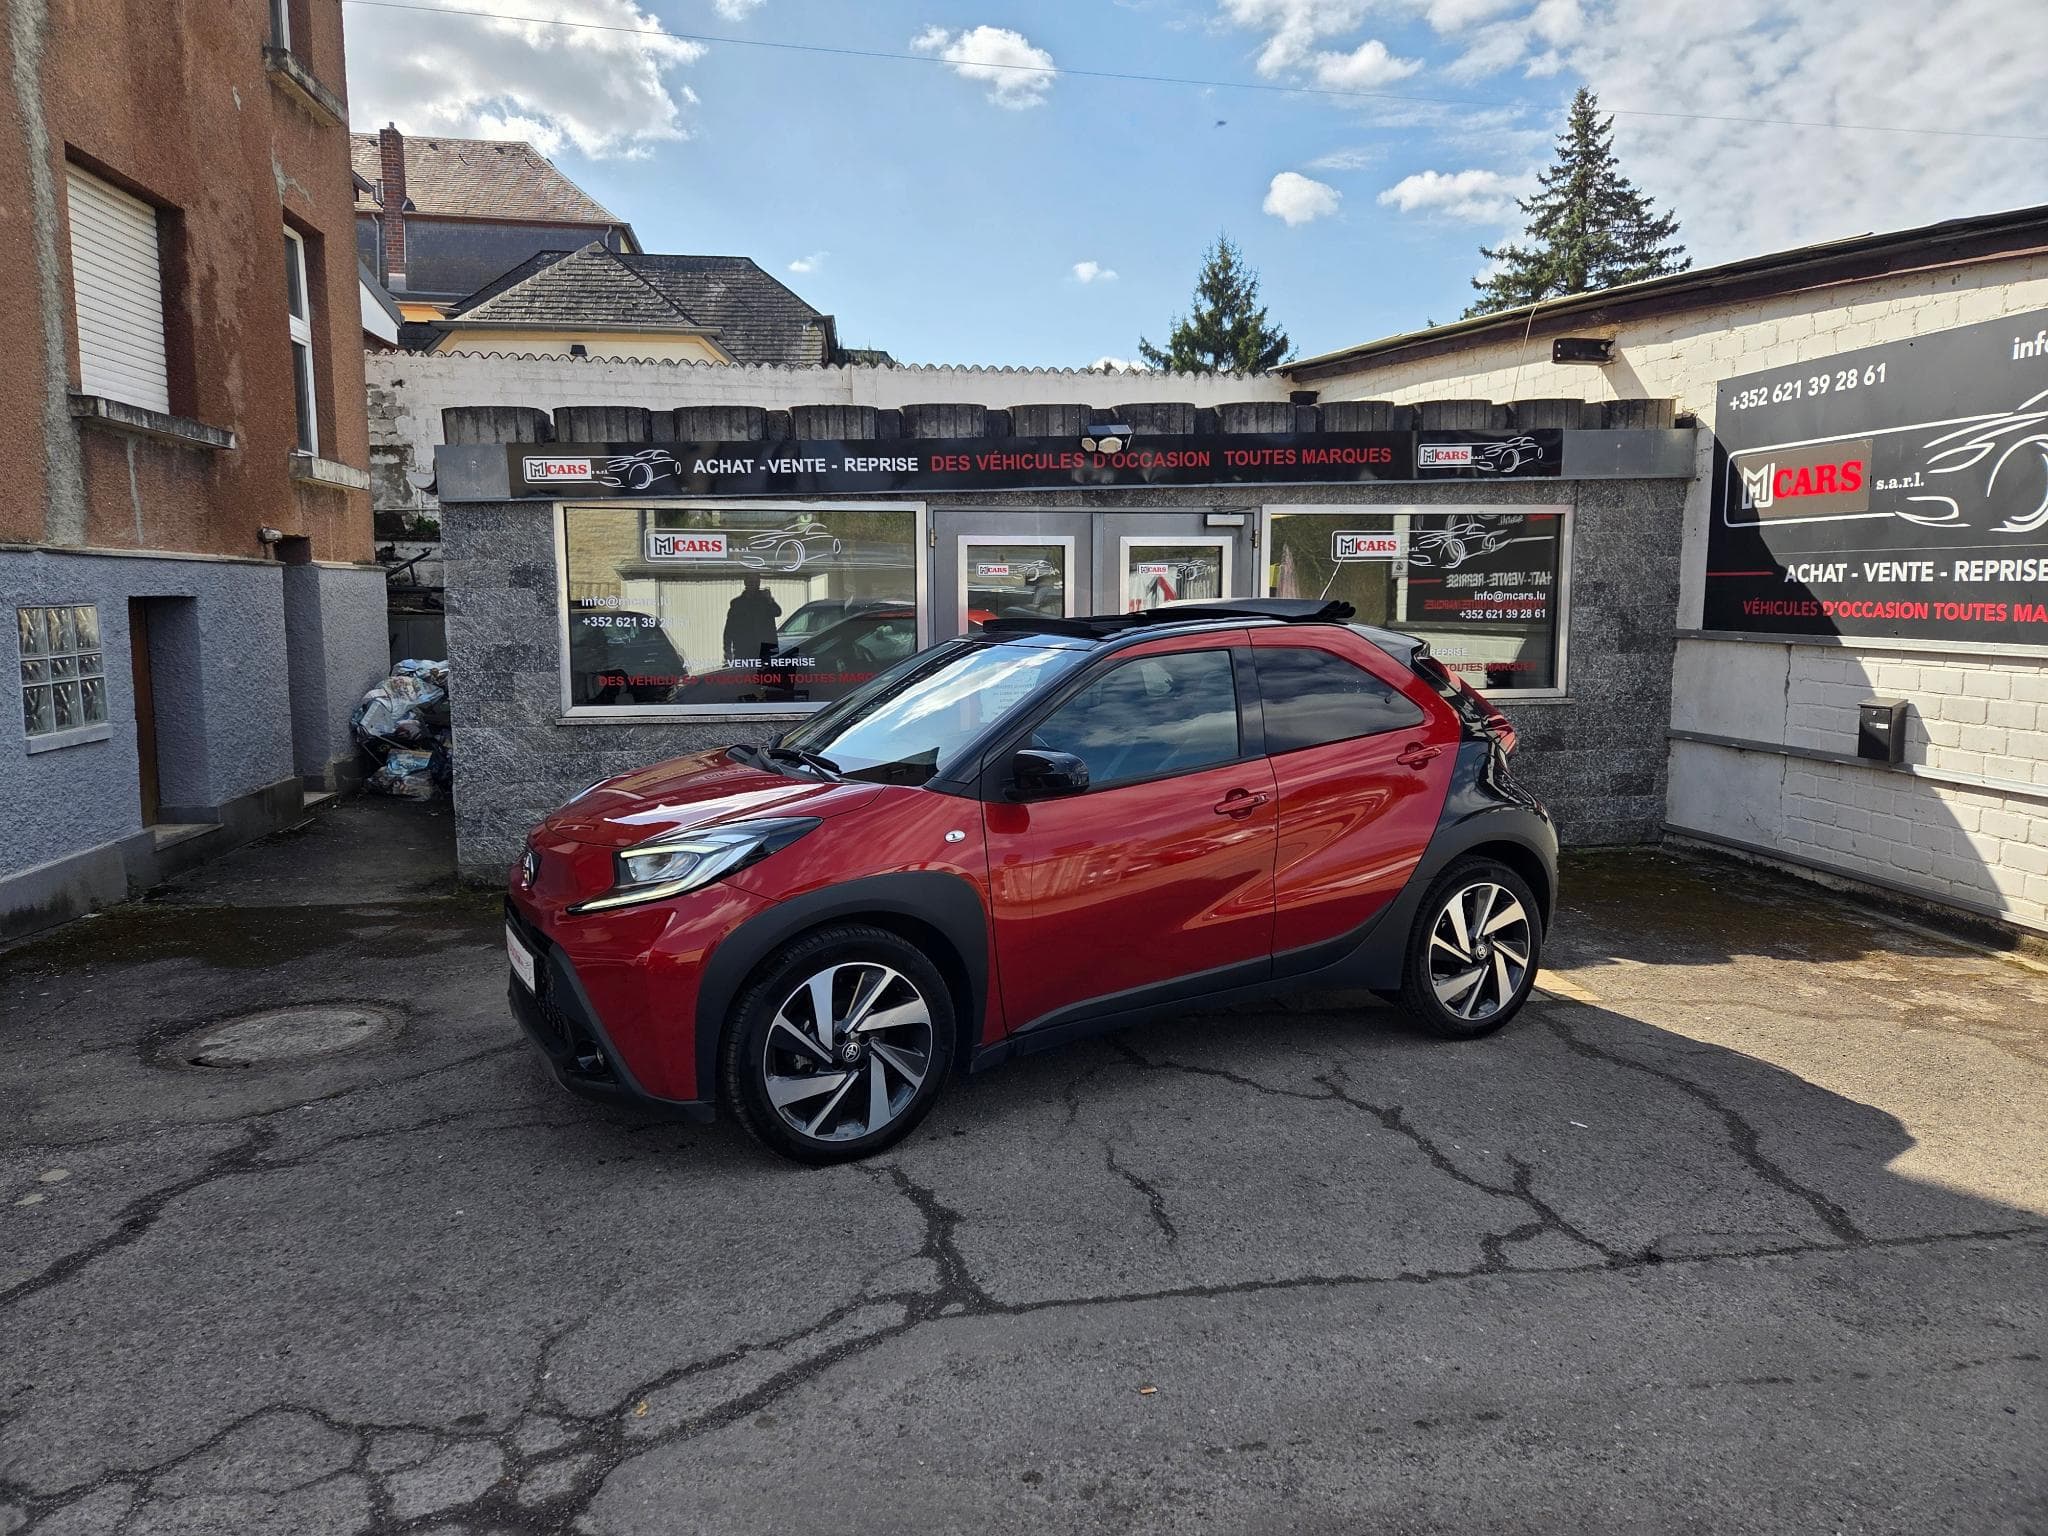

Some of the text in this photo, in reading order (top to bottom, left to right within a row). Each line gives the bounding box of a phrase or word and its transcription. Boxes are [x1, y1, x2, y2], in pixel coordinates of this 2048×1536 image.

[1729, 362, 1886, 411] +352 621 39 28 61
[693, 459, 755, 474] ACHAT
[844, 457, 919, 473] REPRISE
[931, 456, 971, 472] DES
[976, 450, 1085, 471] VÉHICULES
[1224, 450, 1297, 466] TOUTES
[1302, 448, 1392, 465] MARQUES
[1876, 472, 1925, 491] s.a.r.l.
[1784, 563, 1848, 583] ACHAT
[1864, 561, 1935, 583] VENTE
[1954, 559, 2048, 582] REPRISE
[1474, 590, 1546, 602] info@mcars.lu
[1459, 608, 1546, 619] +352 621 39 28 61
[1743, 597, 1818, 617] VÉHICULES
[1823, 600, 1928, 620] D'OCCASION
[1934, 603, 2008, 622] TOUTES
[582, 616, 613, 628] +352
[616, 616, 637, 628] 621
[641, 617, 656, 628] 39
[727, 658, 762, 668] VENTE
[771, 657, 816, 667] REPRISE
[598, 674, 624, 686] DES
[788, 672, 836, 684] TOUTES
